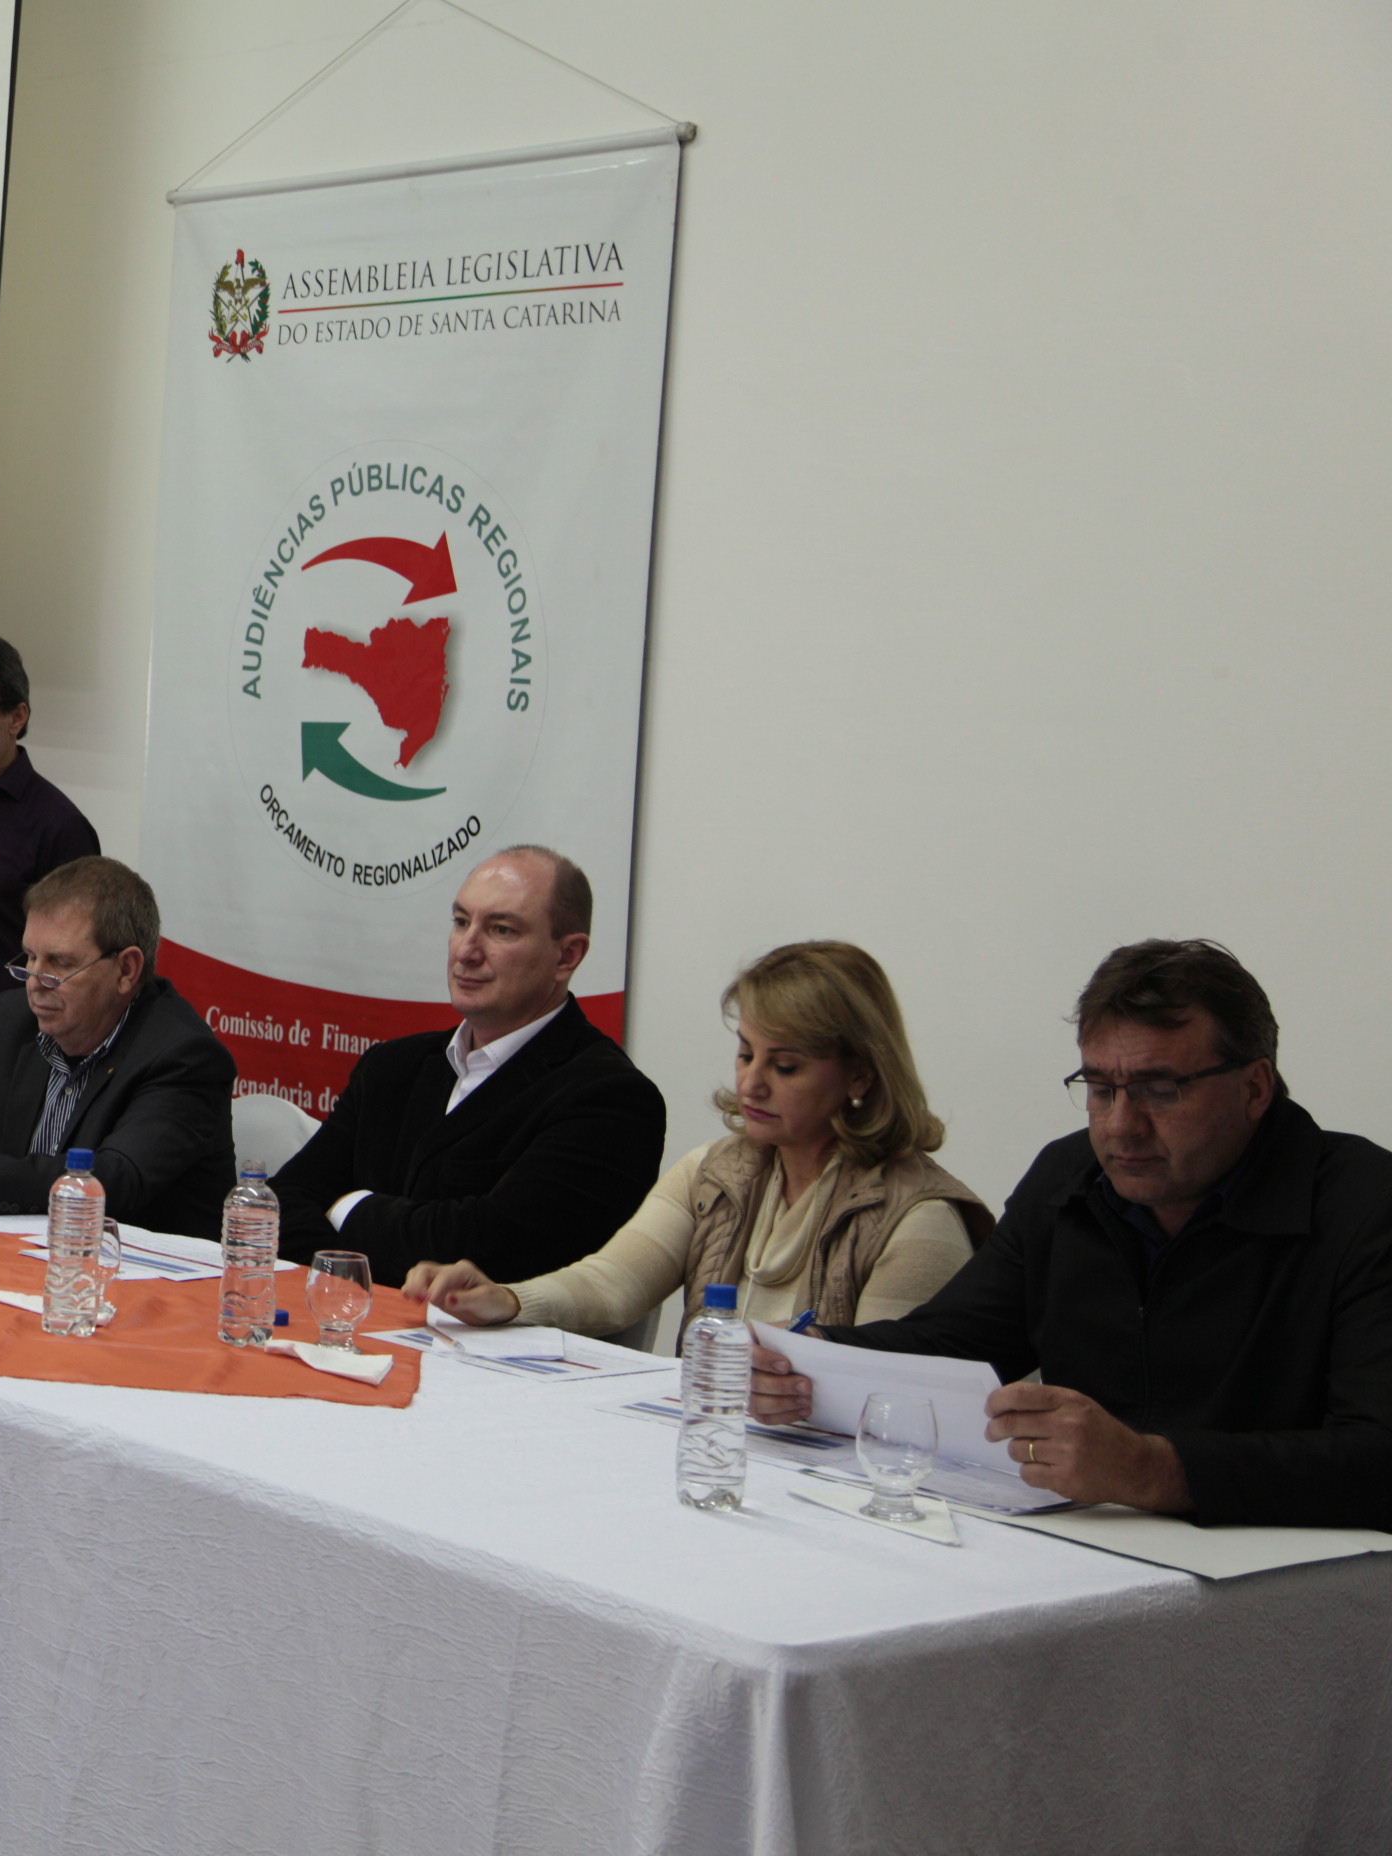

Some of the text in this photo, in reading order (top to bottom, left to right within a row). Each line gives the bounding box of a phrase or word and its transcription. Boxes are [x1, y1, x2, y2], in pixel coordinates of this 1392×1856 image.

[282, 241, 624, 300] ASSEMBLEIA LEGISLATIVA
[277, 299, 621, 346] DO ESTADO DE SANTA CATARINA
[242, 462, 533, 713] AUDIÊNCIAS PÚBLICAS REGIONAIS
[260, 784, 481, 887] ORÇAMENTO REGIONALIZADO
[206, 1006, 388, 1056] Comissão de Finan
